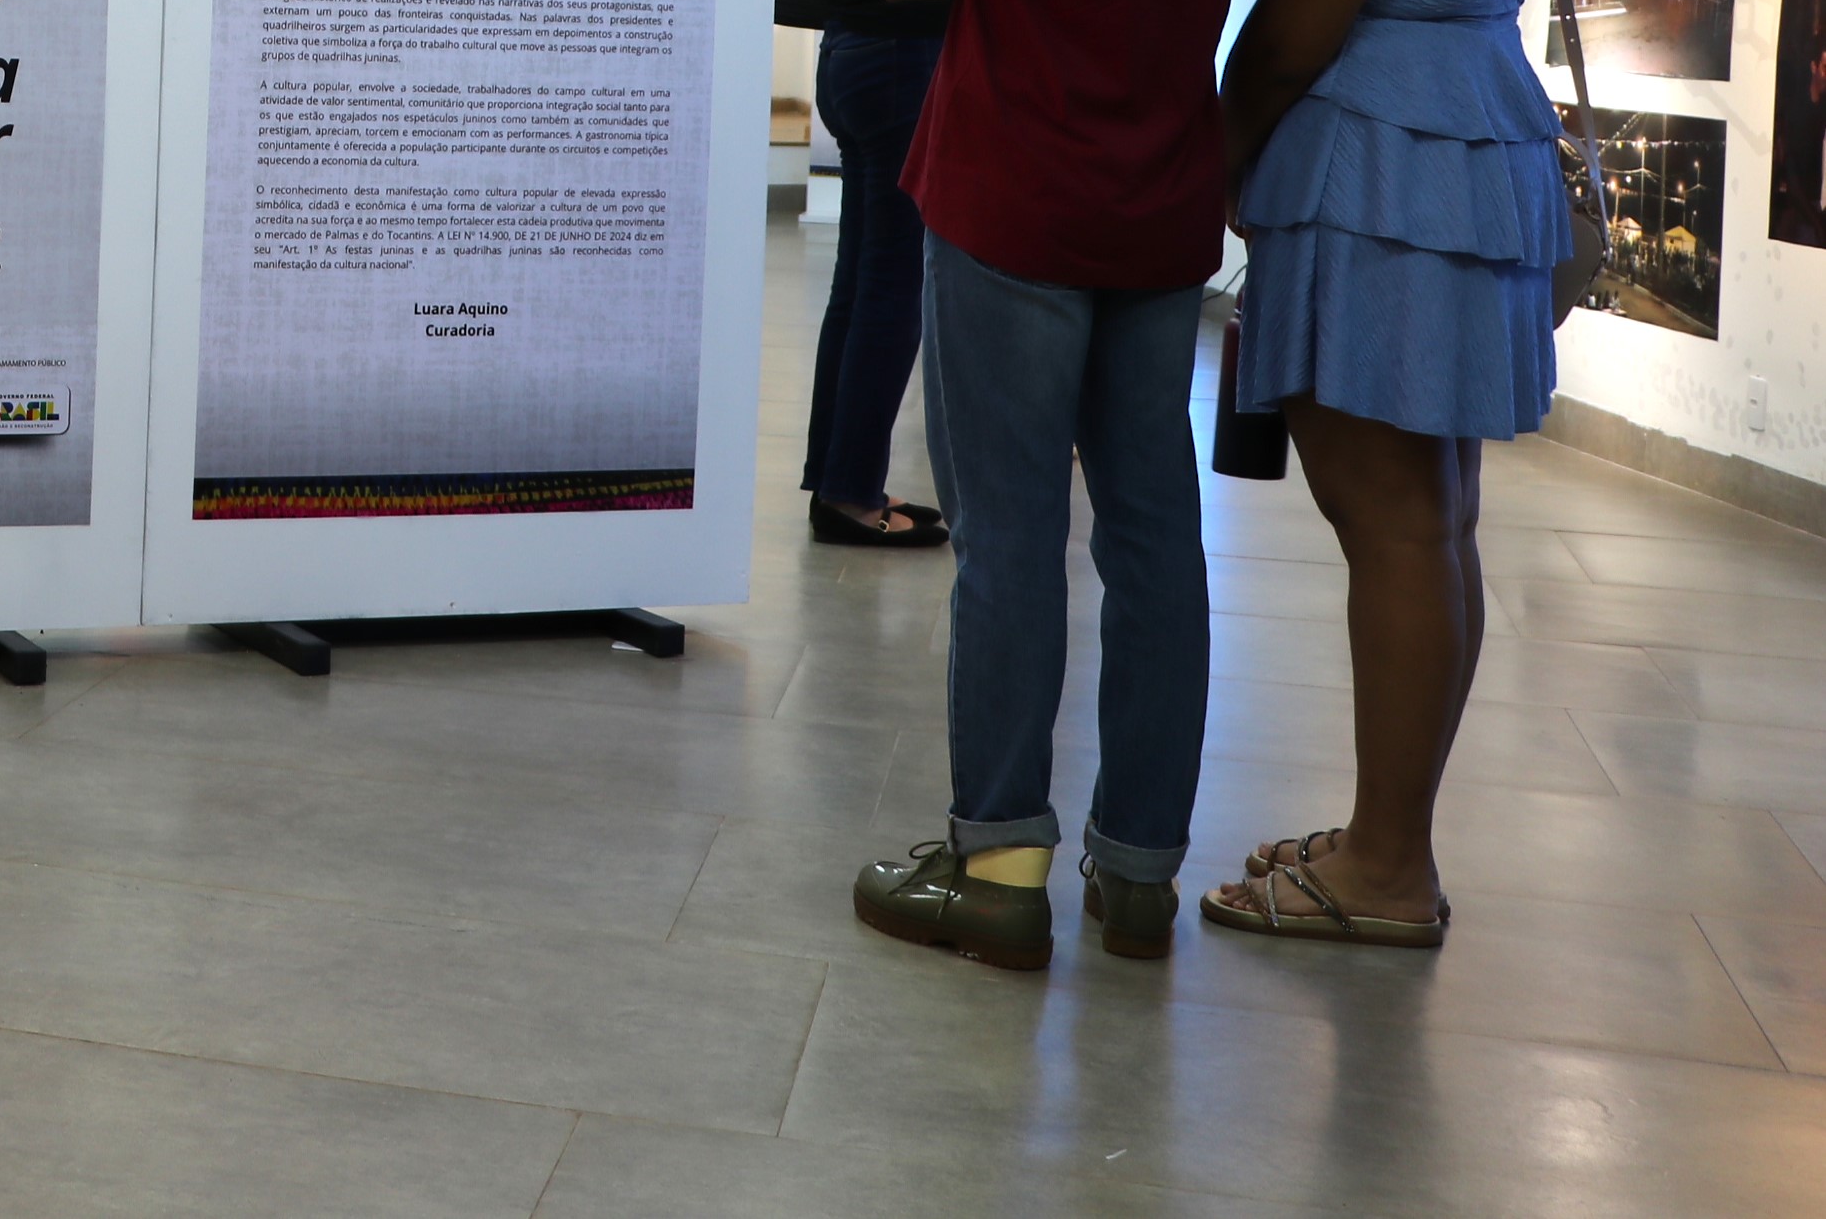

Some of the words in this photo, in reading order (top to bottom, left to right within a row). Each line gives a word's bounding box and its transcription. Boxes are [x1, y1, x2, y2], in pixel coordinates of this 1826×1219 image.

[414, 302, 455, 316] Luara
[457, 301, 508, 319] Aquino
[425, 323, 495, 337] Curadoria
